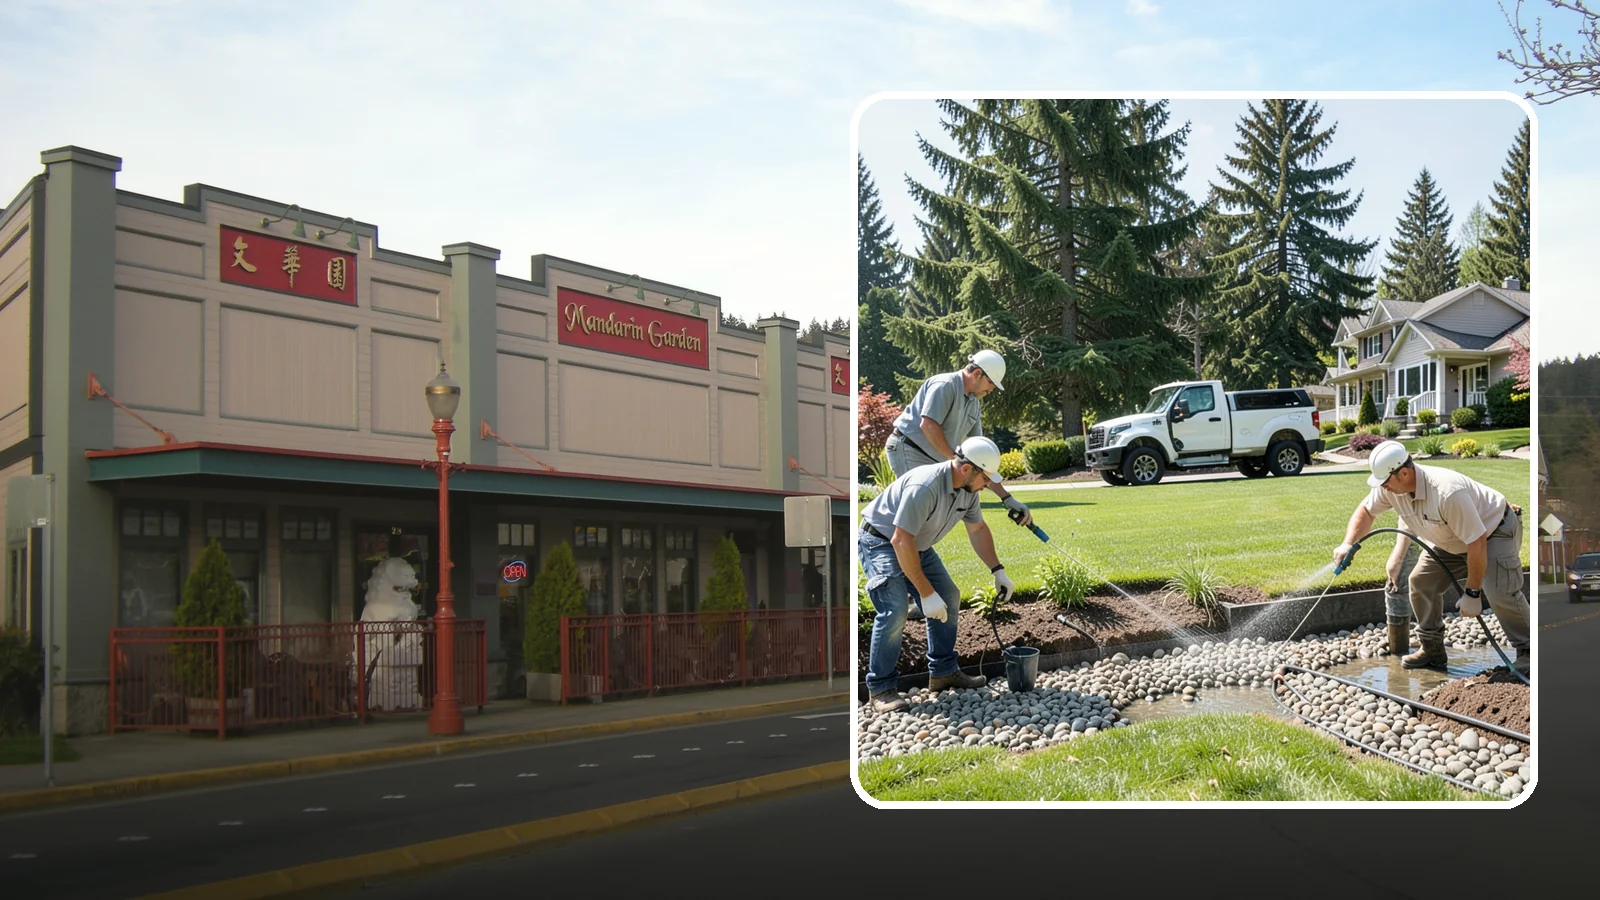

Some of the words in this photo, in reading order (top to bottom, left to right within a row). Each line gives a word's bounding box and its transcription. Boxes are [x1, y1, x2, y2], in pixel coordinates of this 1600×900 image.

[231, 236, 346, 291] 文華園
[564, 302, 644, 341] Mandarin
[648, 320, 702, 352] Garden
[503, 565, 527, 578] OPEN
